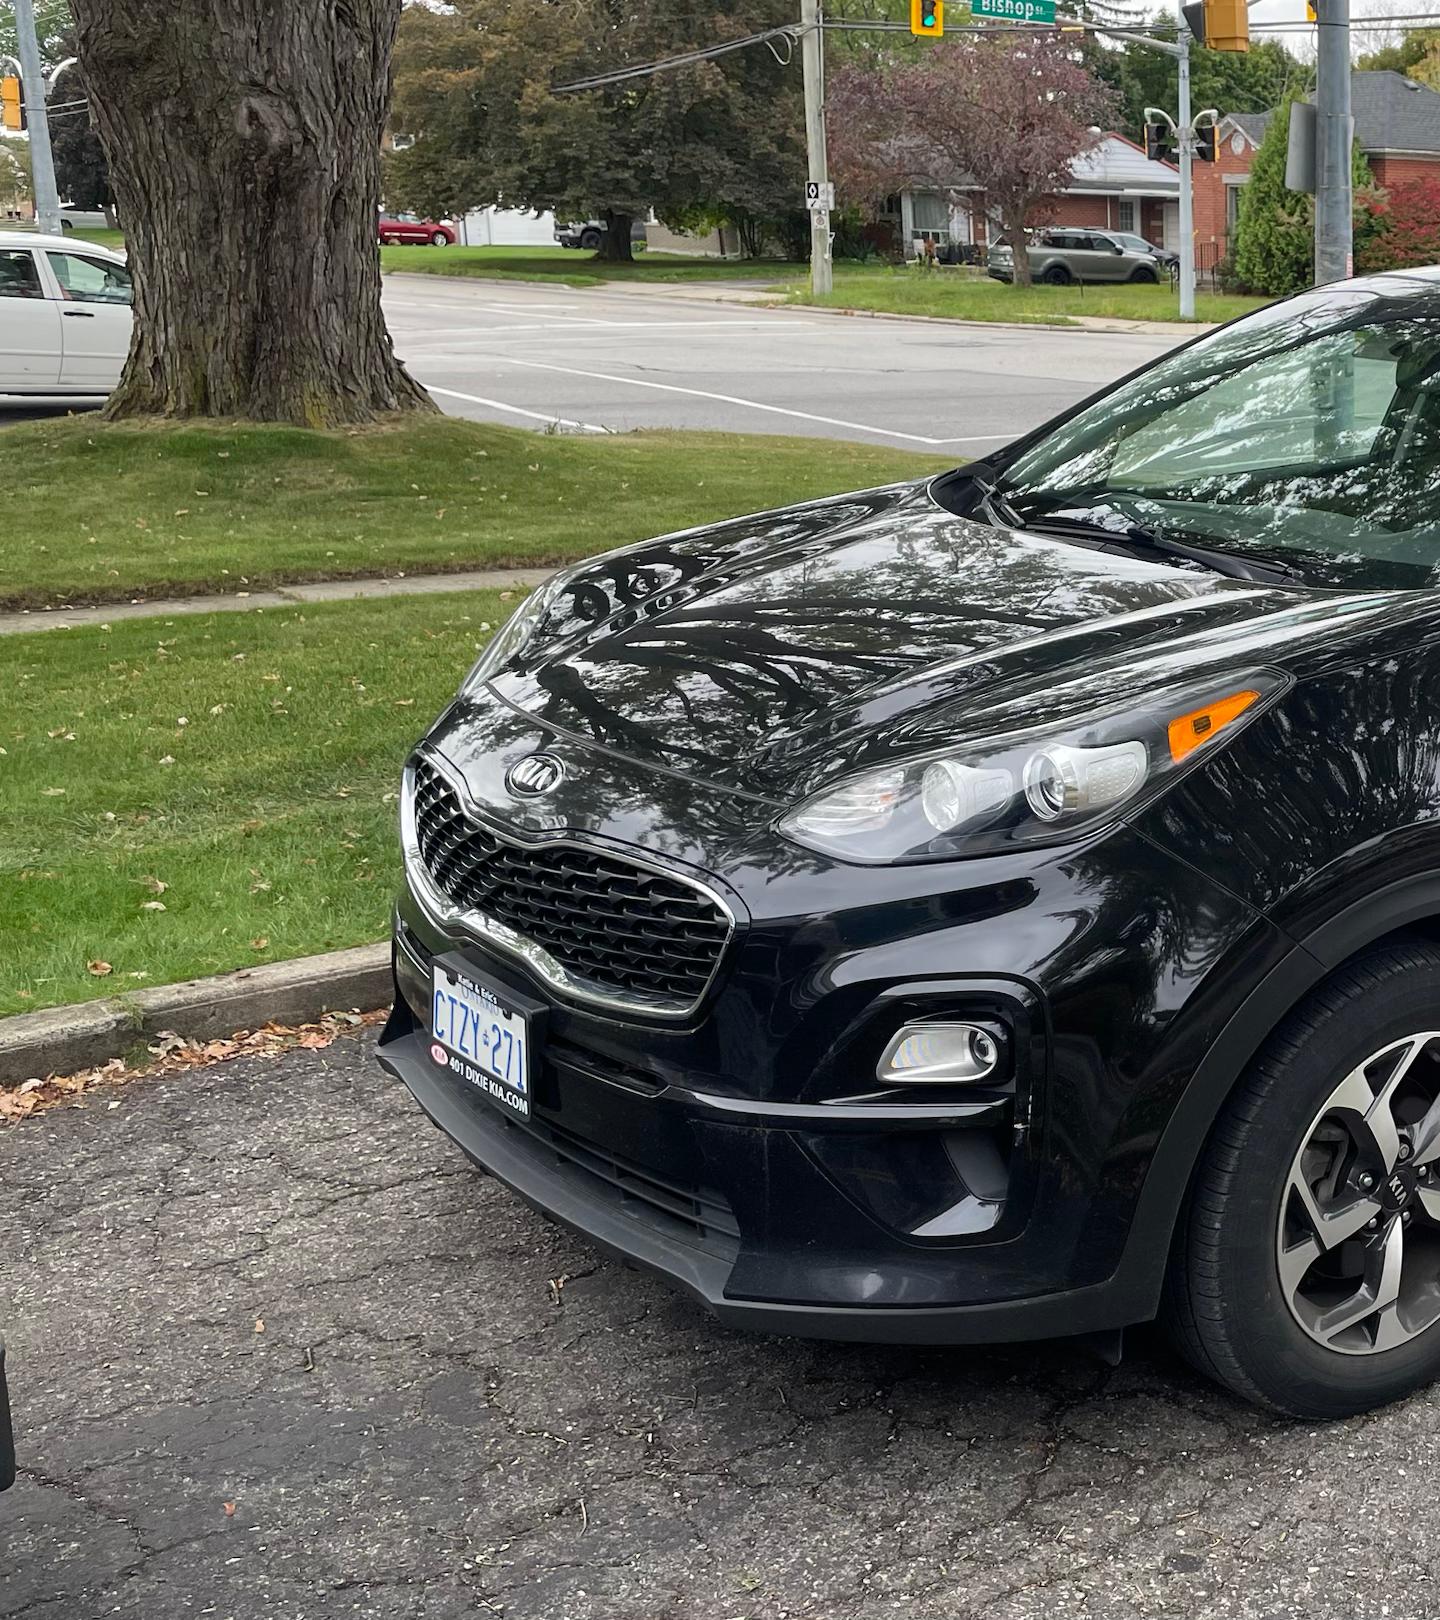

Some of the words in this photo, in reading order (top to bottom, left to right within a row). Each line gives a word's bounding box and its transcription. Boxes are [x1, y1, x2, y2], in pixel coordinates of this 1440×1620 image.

[981, 0, 1034, 20] Bishop
[434, 989, 480, 1061] CTZY
[491, 1023, 525, 1090] 271
[449, 1056, 464, 1076] 401
[465, 1065, 488, 1091] DIXIE
[488, 1079, 529, 1115] KIA.COM
[1388, 1175, 1407, 1206] KIA
